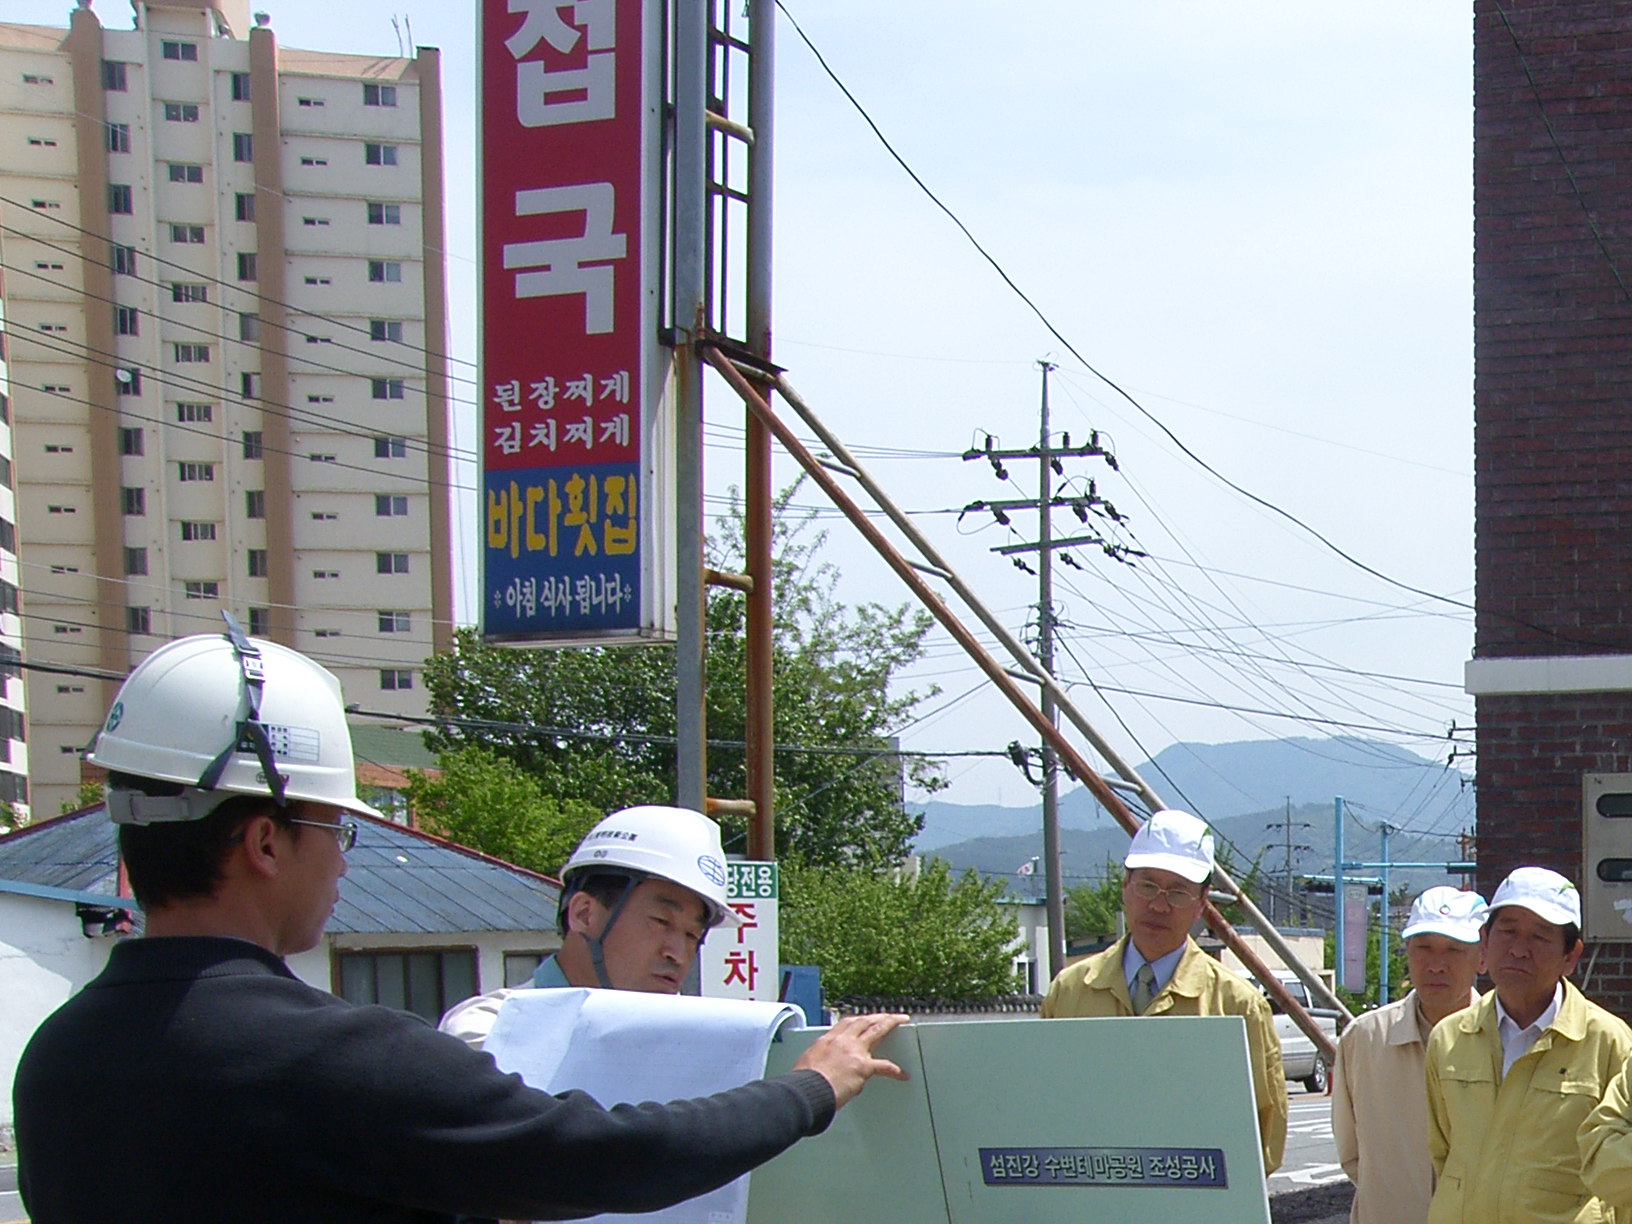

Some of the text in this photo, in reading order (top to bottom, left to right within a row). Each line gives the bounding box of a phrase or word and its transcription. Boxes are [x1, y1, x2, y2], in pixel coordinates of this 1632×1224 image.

[493, 370, 630, 412] 된장찌게
[493, 413, 630, 455] 김치찌게
[487, 472, 637, 559] 바다횟집
[506, 572, 622, 618] 아침 식사 됩니다
[723, 903, 759, 1001] 주차
[990, 1154, 1216, 1180] 섬진강 수변테마공원 조성공사
